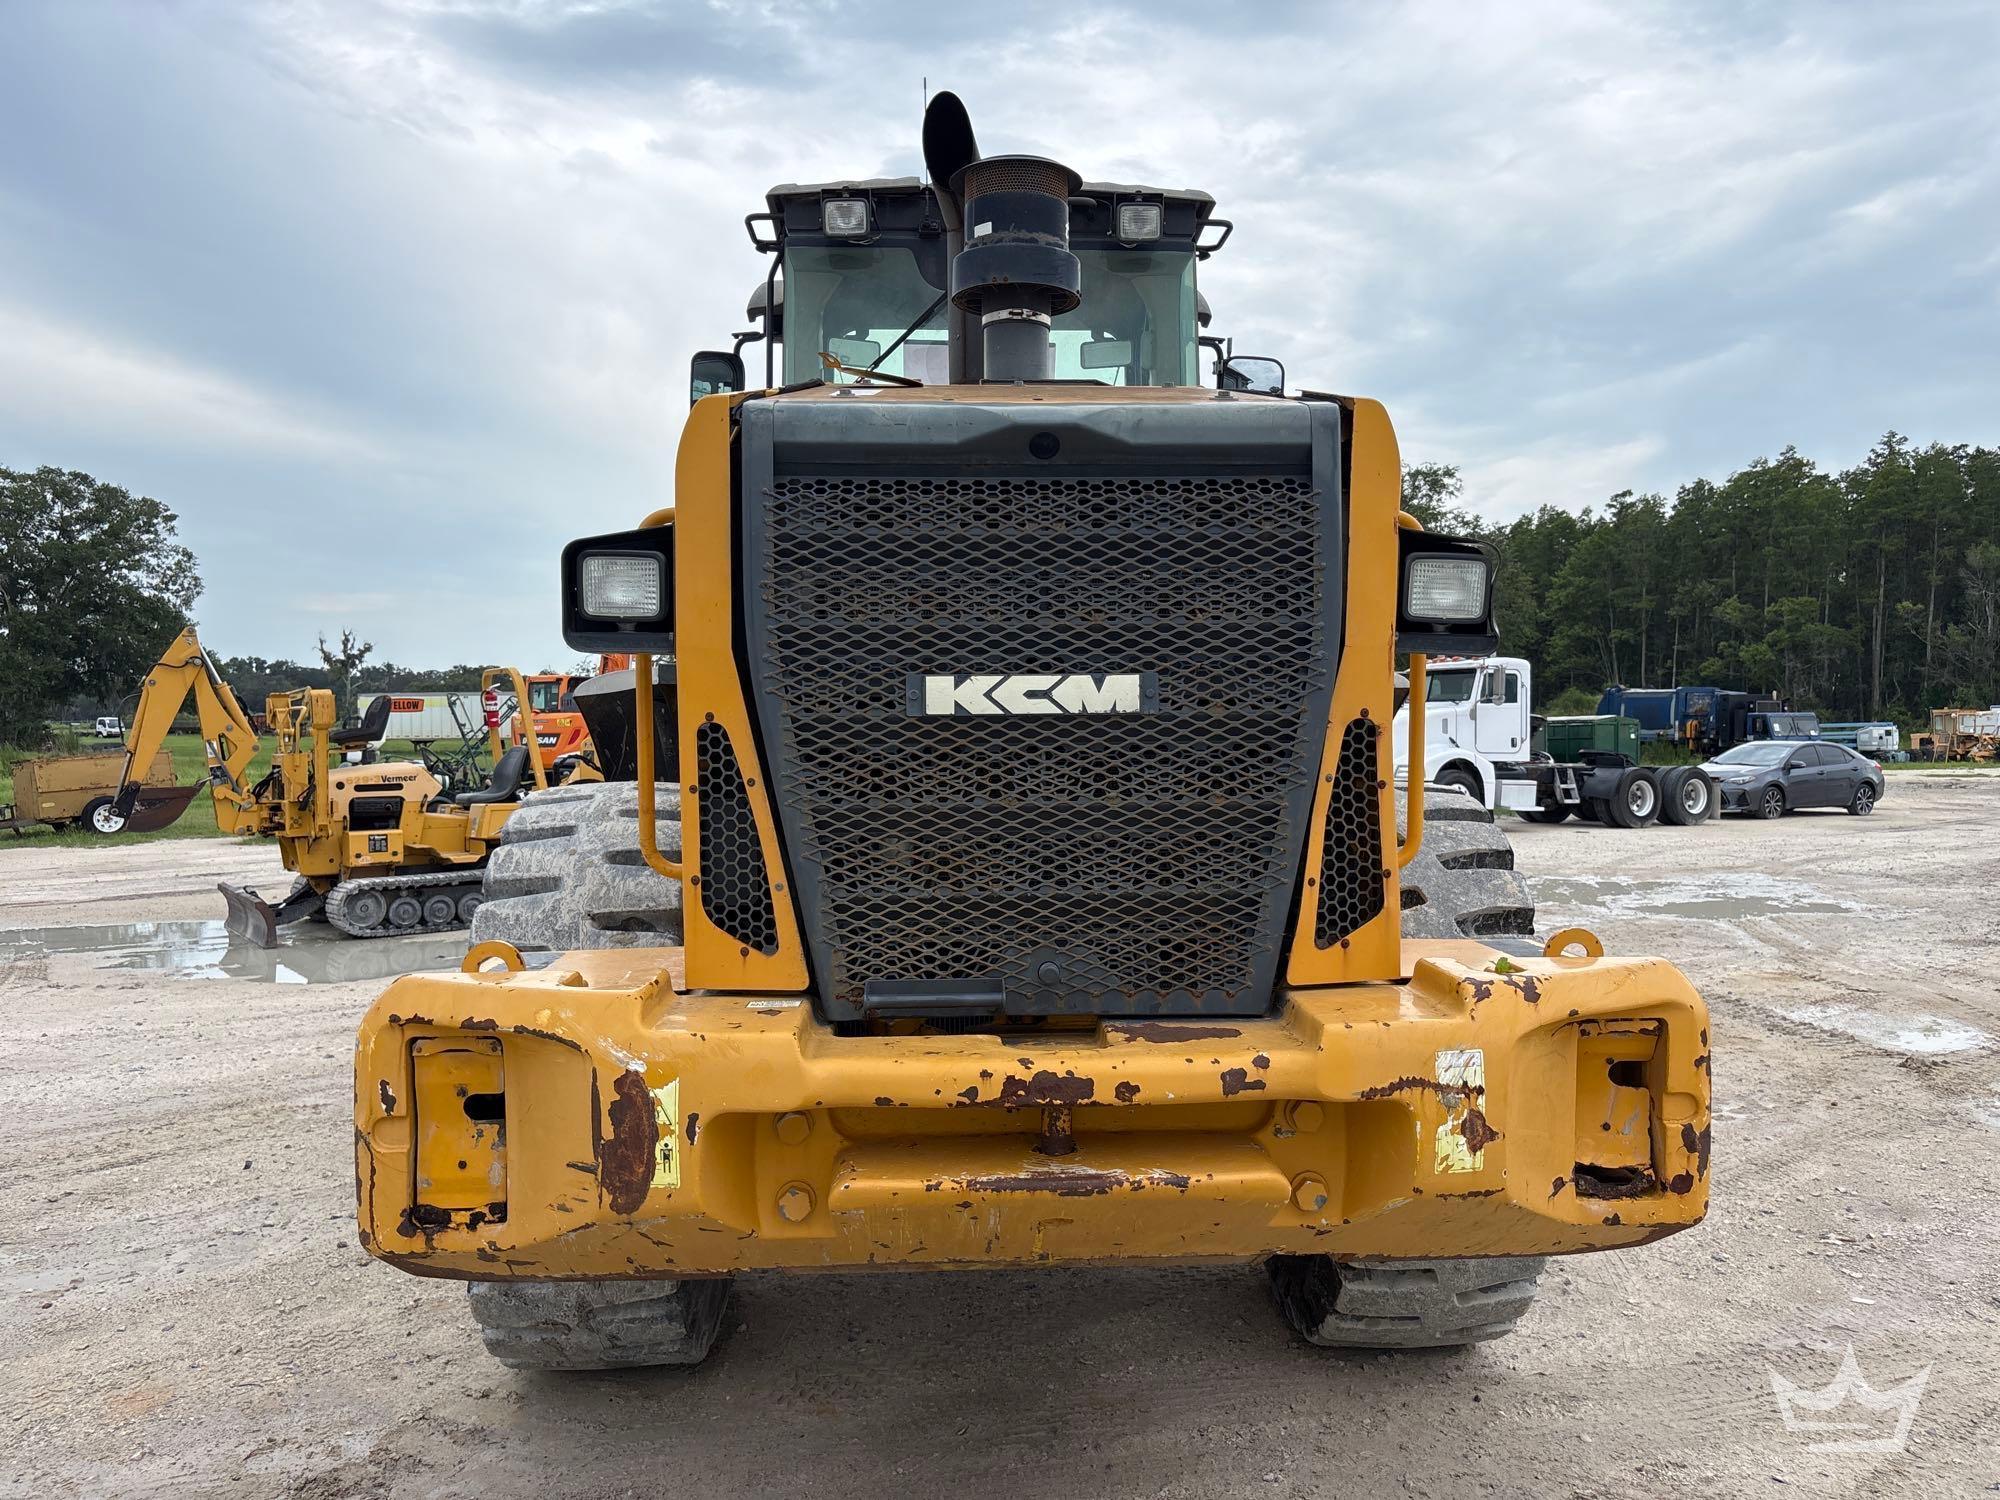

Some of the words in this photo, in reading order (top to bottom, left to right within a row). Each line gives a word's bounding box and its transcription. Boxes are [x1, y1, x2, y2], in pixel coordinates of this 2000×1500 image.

[925, 674, 1140, 715] KCM
[391, 700, 420, 710] ELLOW
[522, 736, 557, 744] DSAN
[381, 775, 417, 783] Vermeer
